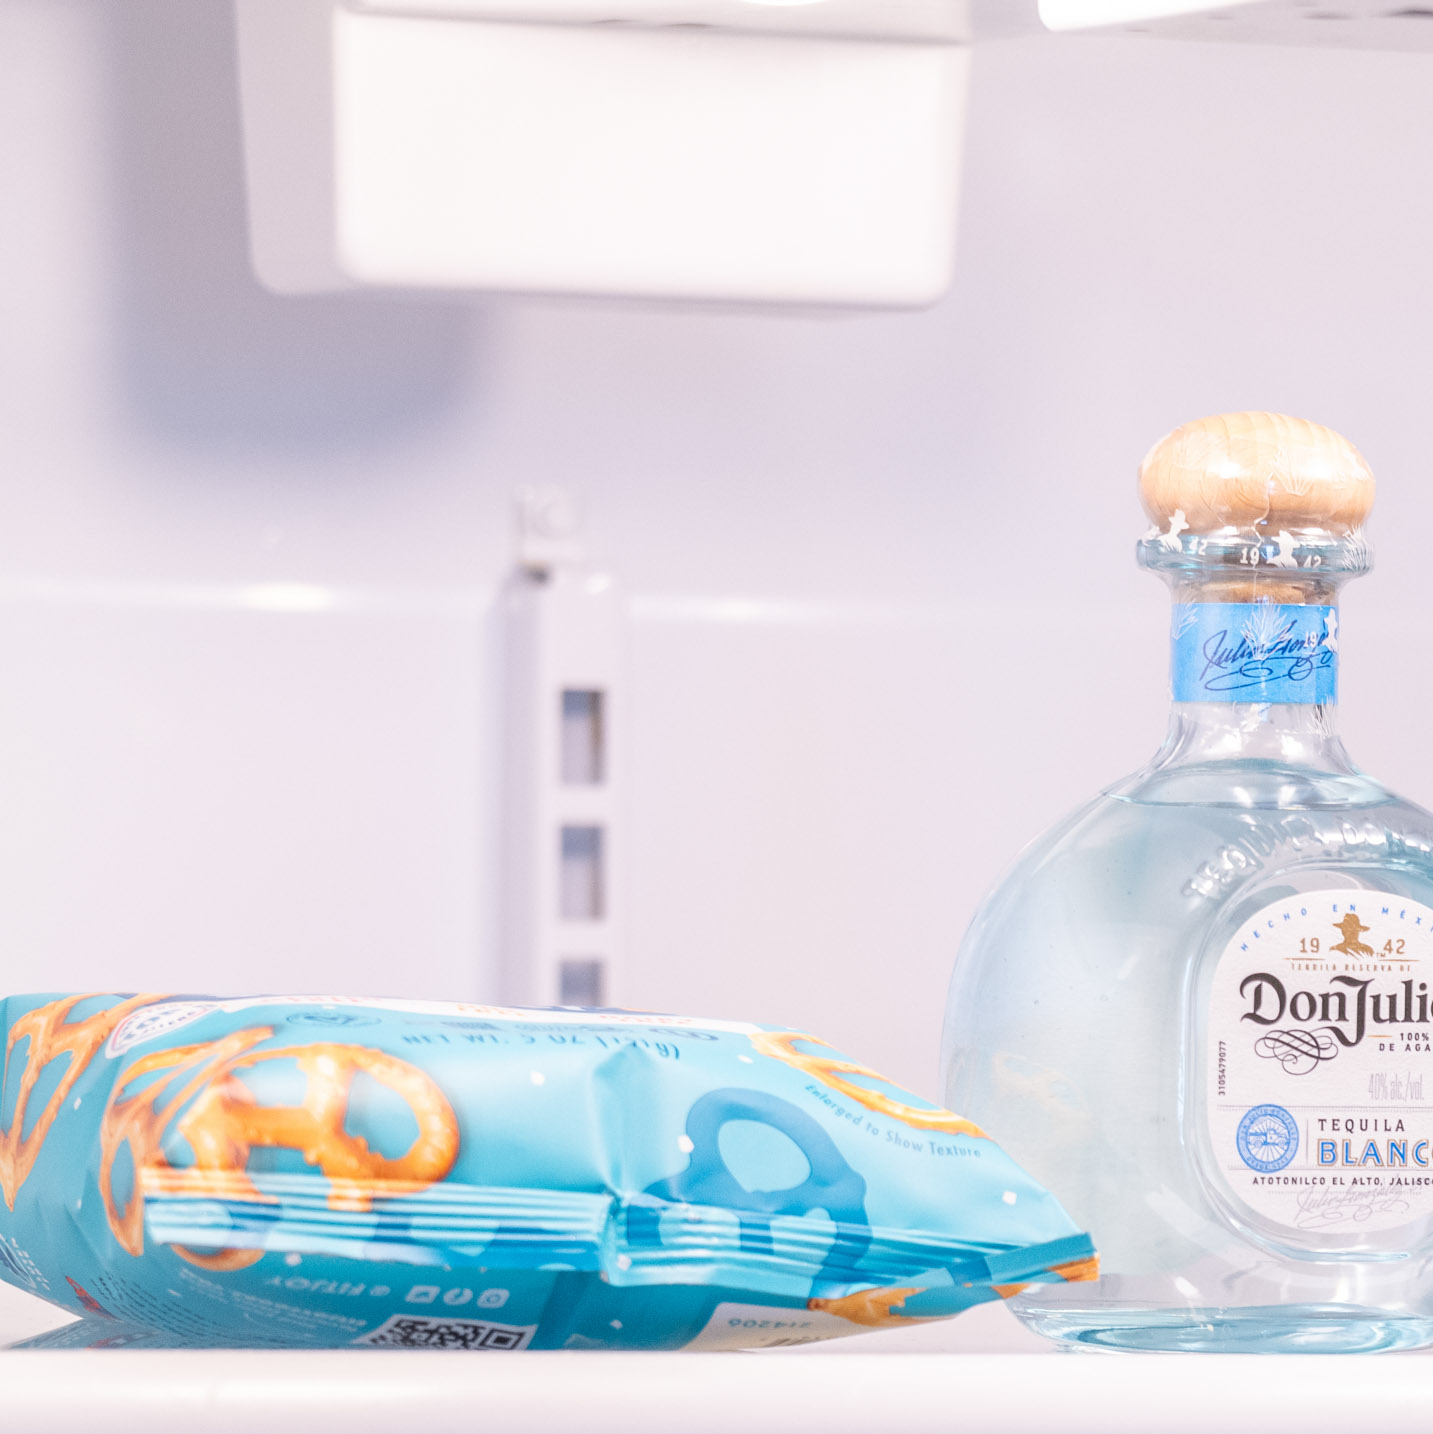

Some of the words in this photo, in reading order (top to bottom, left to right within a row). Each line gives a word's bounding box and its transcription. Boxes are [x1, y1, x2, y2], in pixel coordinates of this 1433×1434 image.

[1240, 907, 1308, 953] HECHO
[1332, 904, 1357, 913] EN
[1299, 937, 1320, 954] 19
[1383, 938, 1407, 955] 42
[1400, 1032, 1430, 1042] 100%
[1379, 1043, 1395, 1052] DE
[1318, 1118, 1406, 1134] TEQUILA
[885, 1129, 924, 1153] Show
[928, 1141, 982, 1158] Texture
[1252, 1176, 1326, 1186] ATOTONILCO
[1332, 1177, 1345, 1186] EL
